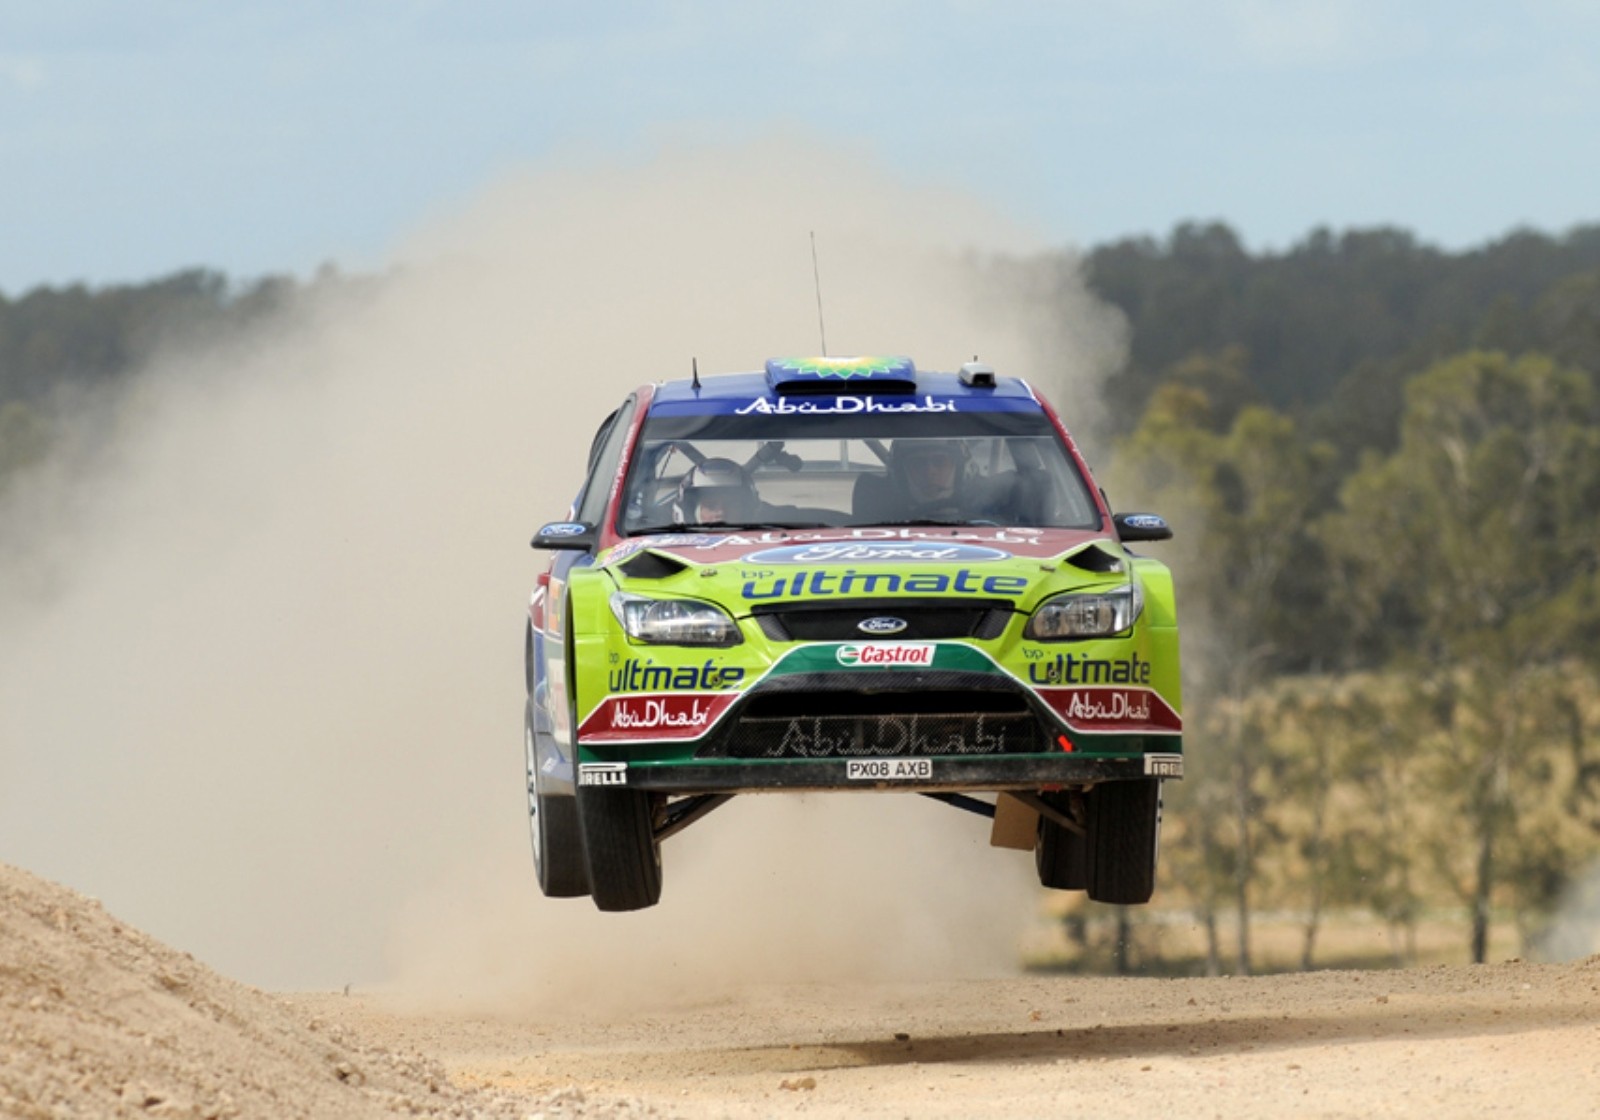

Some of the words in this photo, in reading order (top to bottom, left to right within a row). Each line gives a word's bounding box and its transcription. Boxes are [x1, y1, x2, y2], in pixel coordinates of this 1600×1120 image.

[735, 397, 832, 414] Abu
[832, 396, 958, 412] Dhabi
[697, 532, 838, 549] Abu
[793, 545, 961, 559] Ford
[742, 569, 1028, 599] ultimate
[868, 618, 898, 630] Ford
[861, 645, 929, 663] Castrol
[1023, 648, 1044, 659] bp
[610, 658, 745, 692] ultimate
[1029, 652, 1150, 684] ultimate
[611, 700, 648, 728] Abu
[644, 699, 710, 727] Dhabi
[1066, 692, 1112, 719] Abu
[766, 718, 868, 757] Abu
[868, 714, 1007, 755] Dhabi
[850, 764, 890, 776] PX08
[895, 762, 931, 776] AXB
